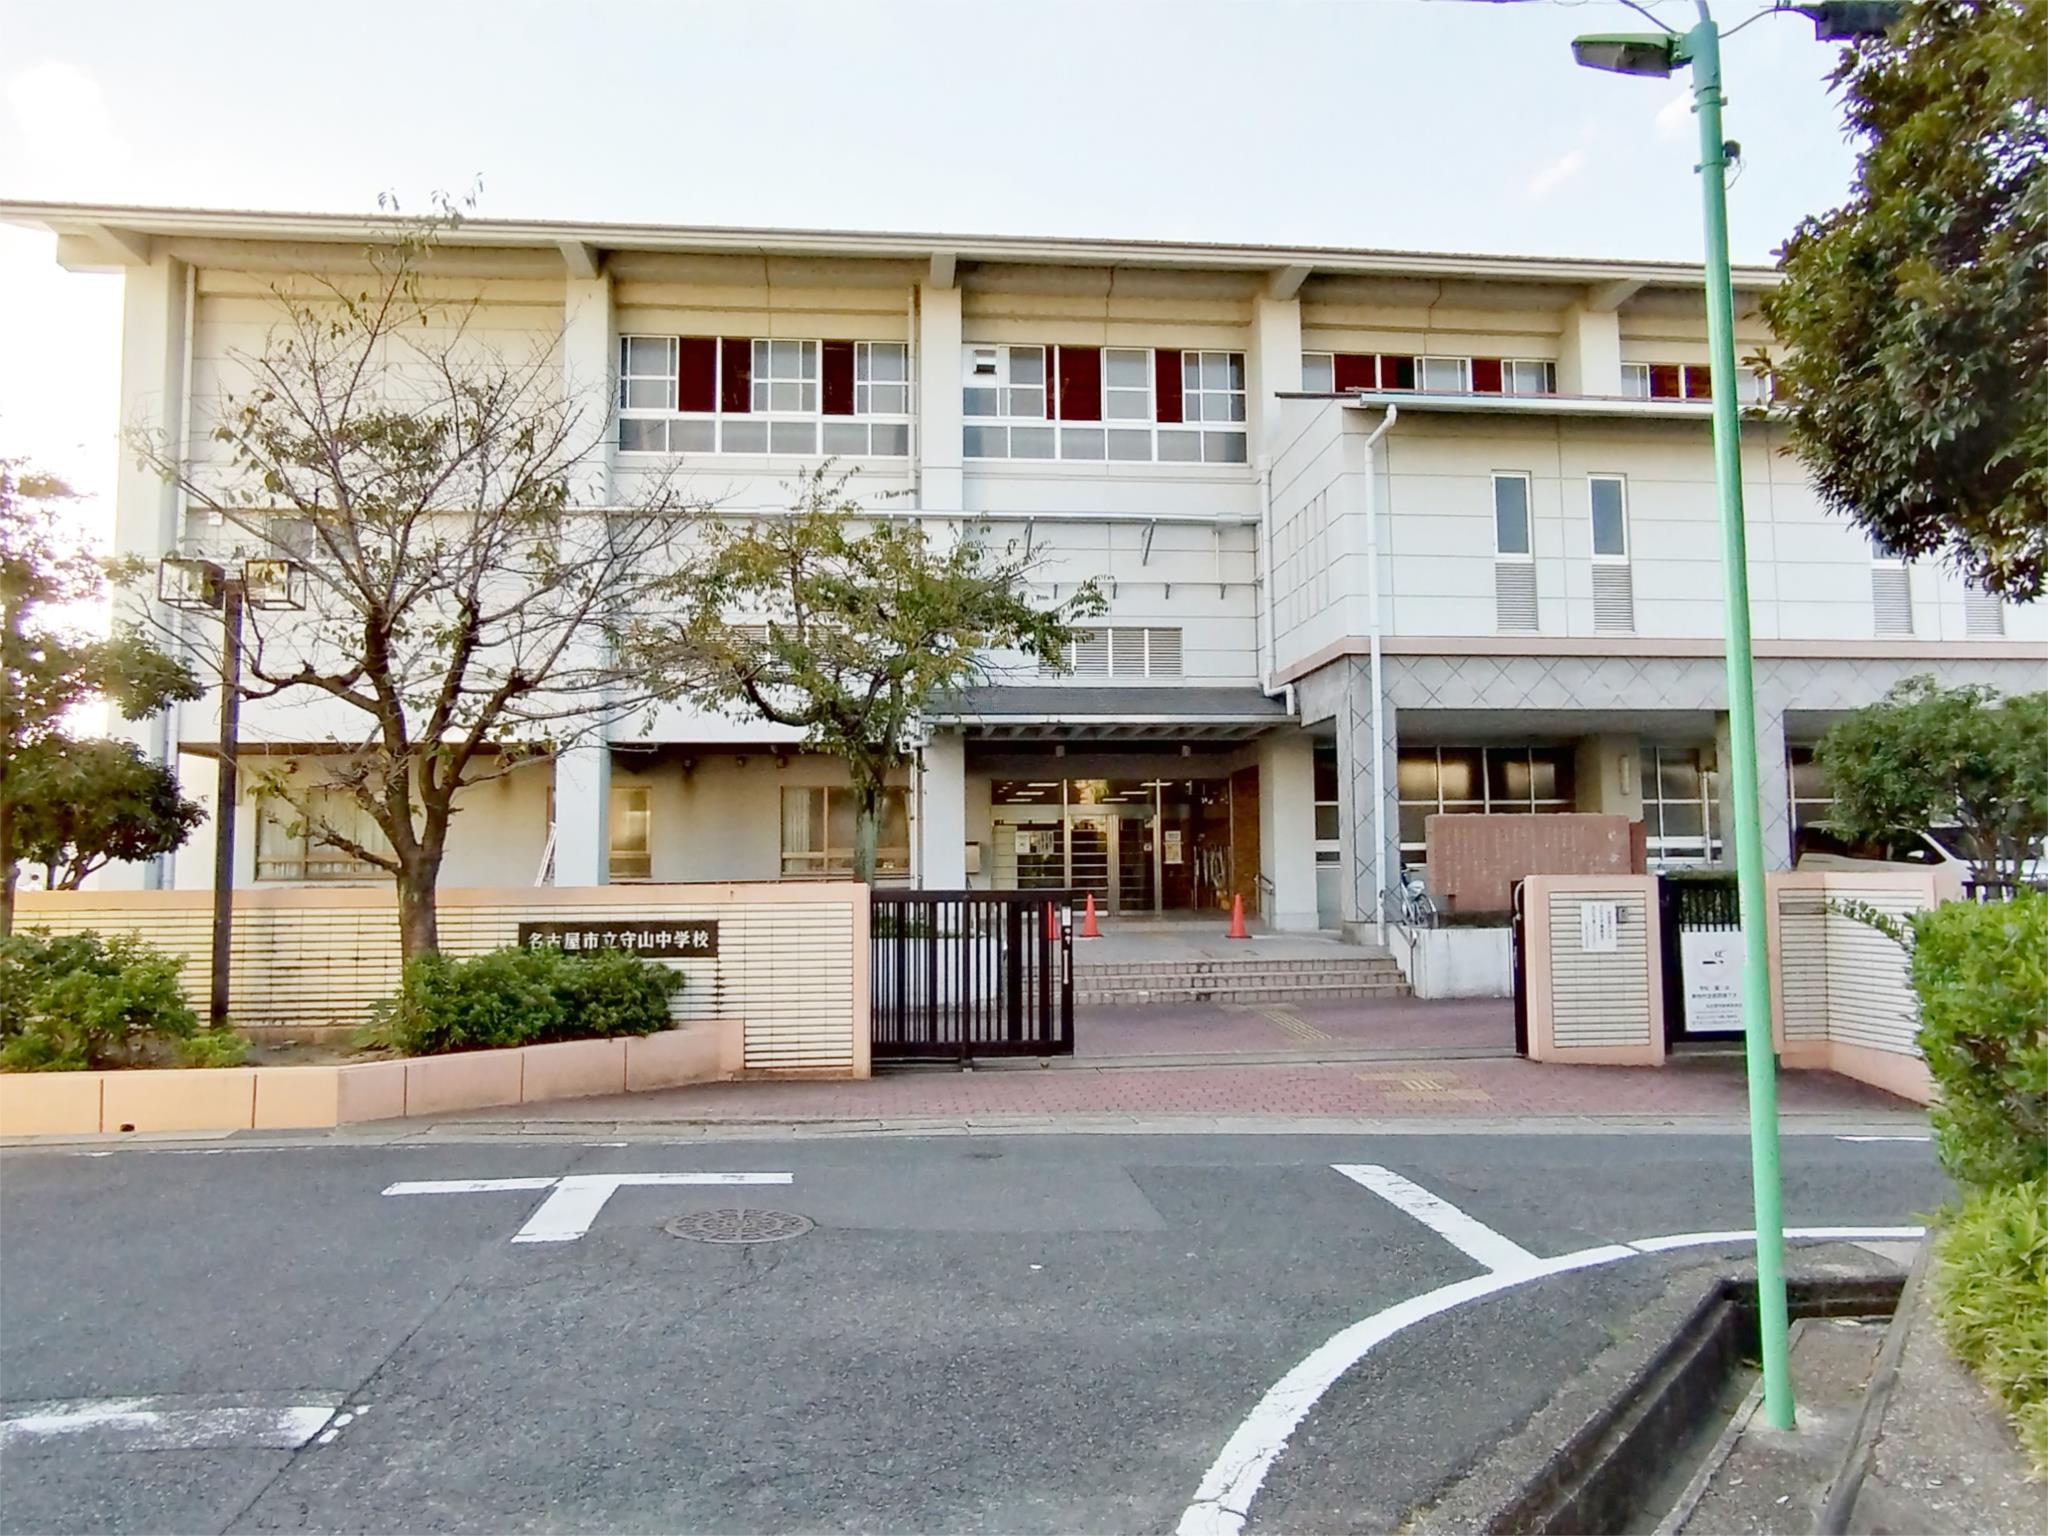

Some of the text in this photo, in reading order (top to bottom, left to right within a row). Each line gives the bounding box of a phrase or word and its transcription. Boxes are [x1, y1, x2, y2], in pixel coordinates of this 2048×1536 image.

[527, 930, 710, 950] 名古屋市立守山中学校
